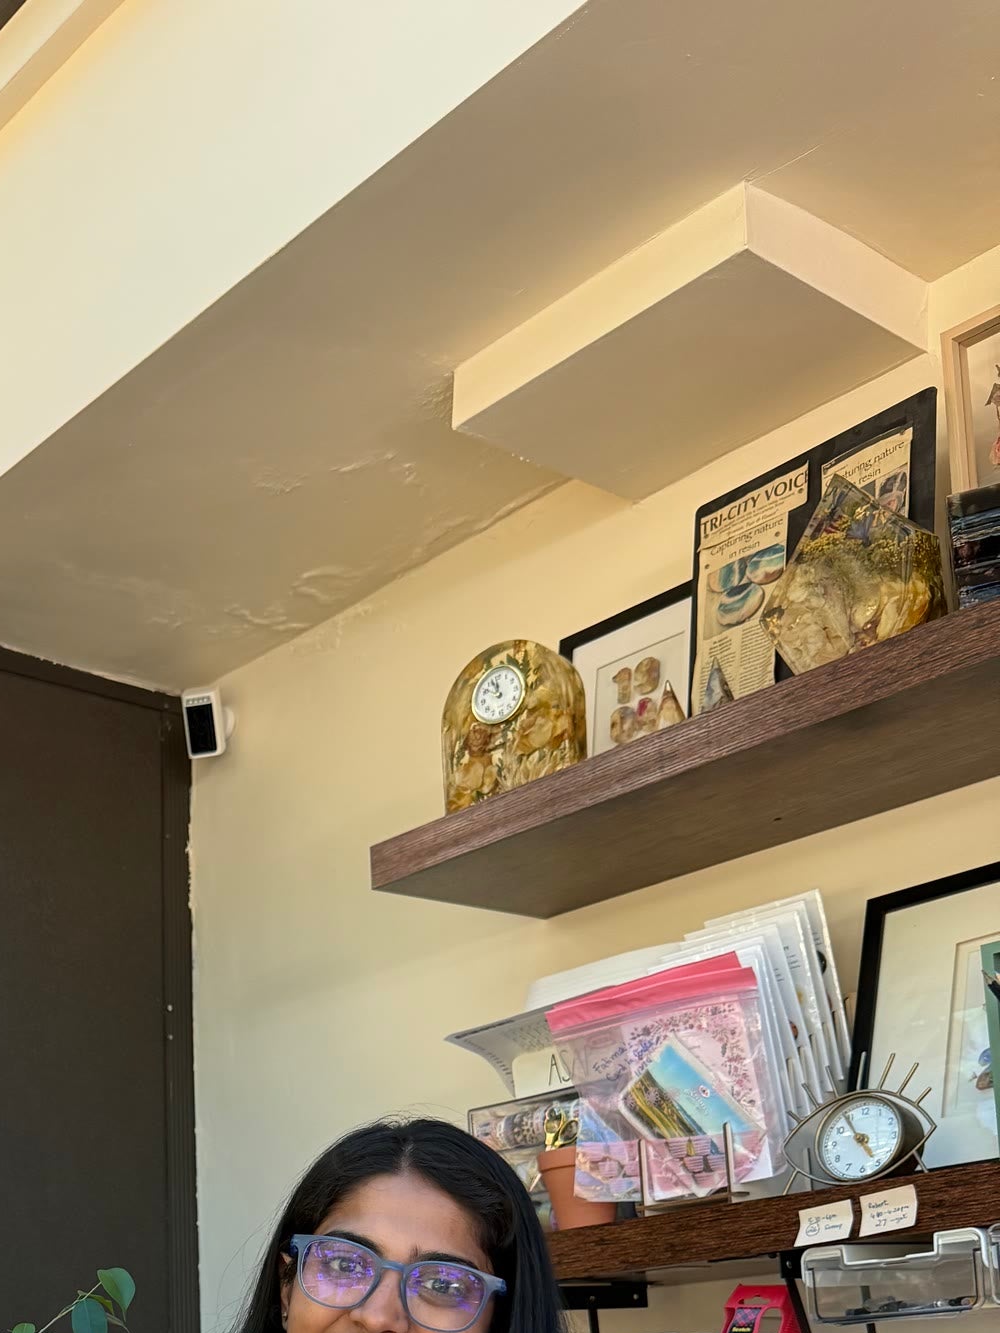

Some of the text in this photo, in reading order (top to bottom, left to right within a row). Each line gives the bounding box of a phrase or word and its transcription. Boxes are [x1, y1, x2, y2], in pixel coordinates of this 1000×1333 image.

[874, 441, 905, 464] nature
[859, 468, 881, 485] resin
[701, 493, 761, 536] TRI-CITY
[710, 518, 784, 556] Capturing nature
[729, 541, 760, 559] in resin
